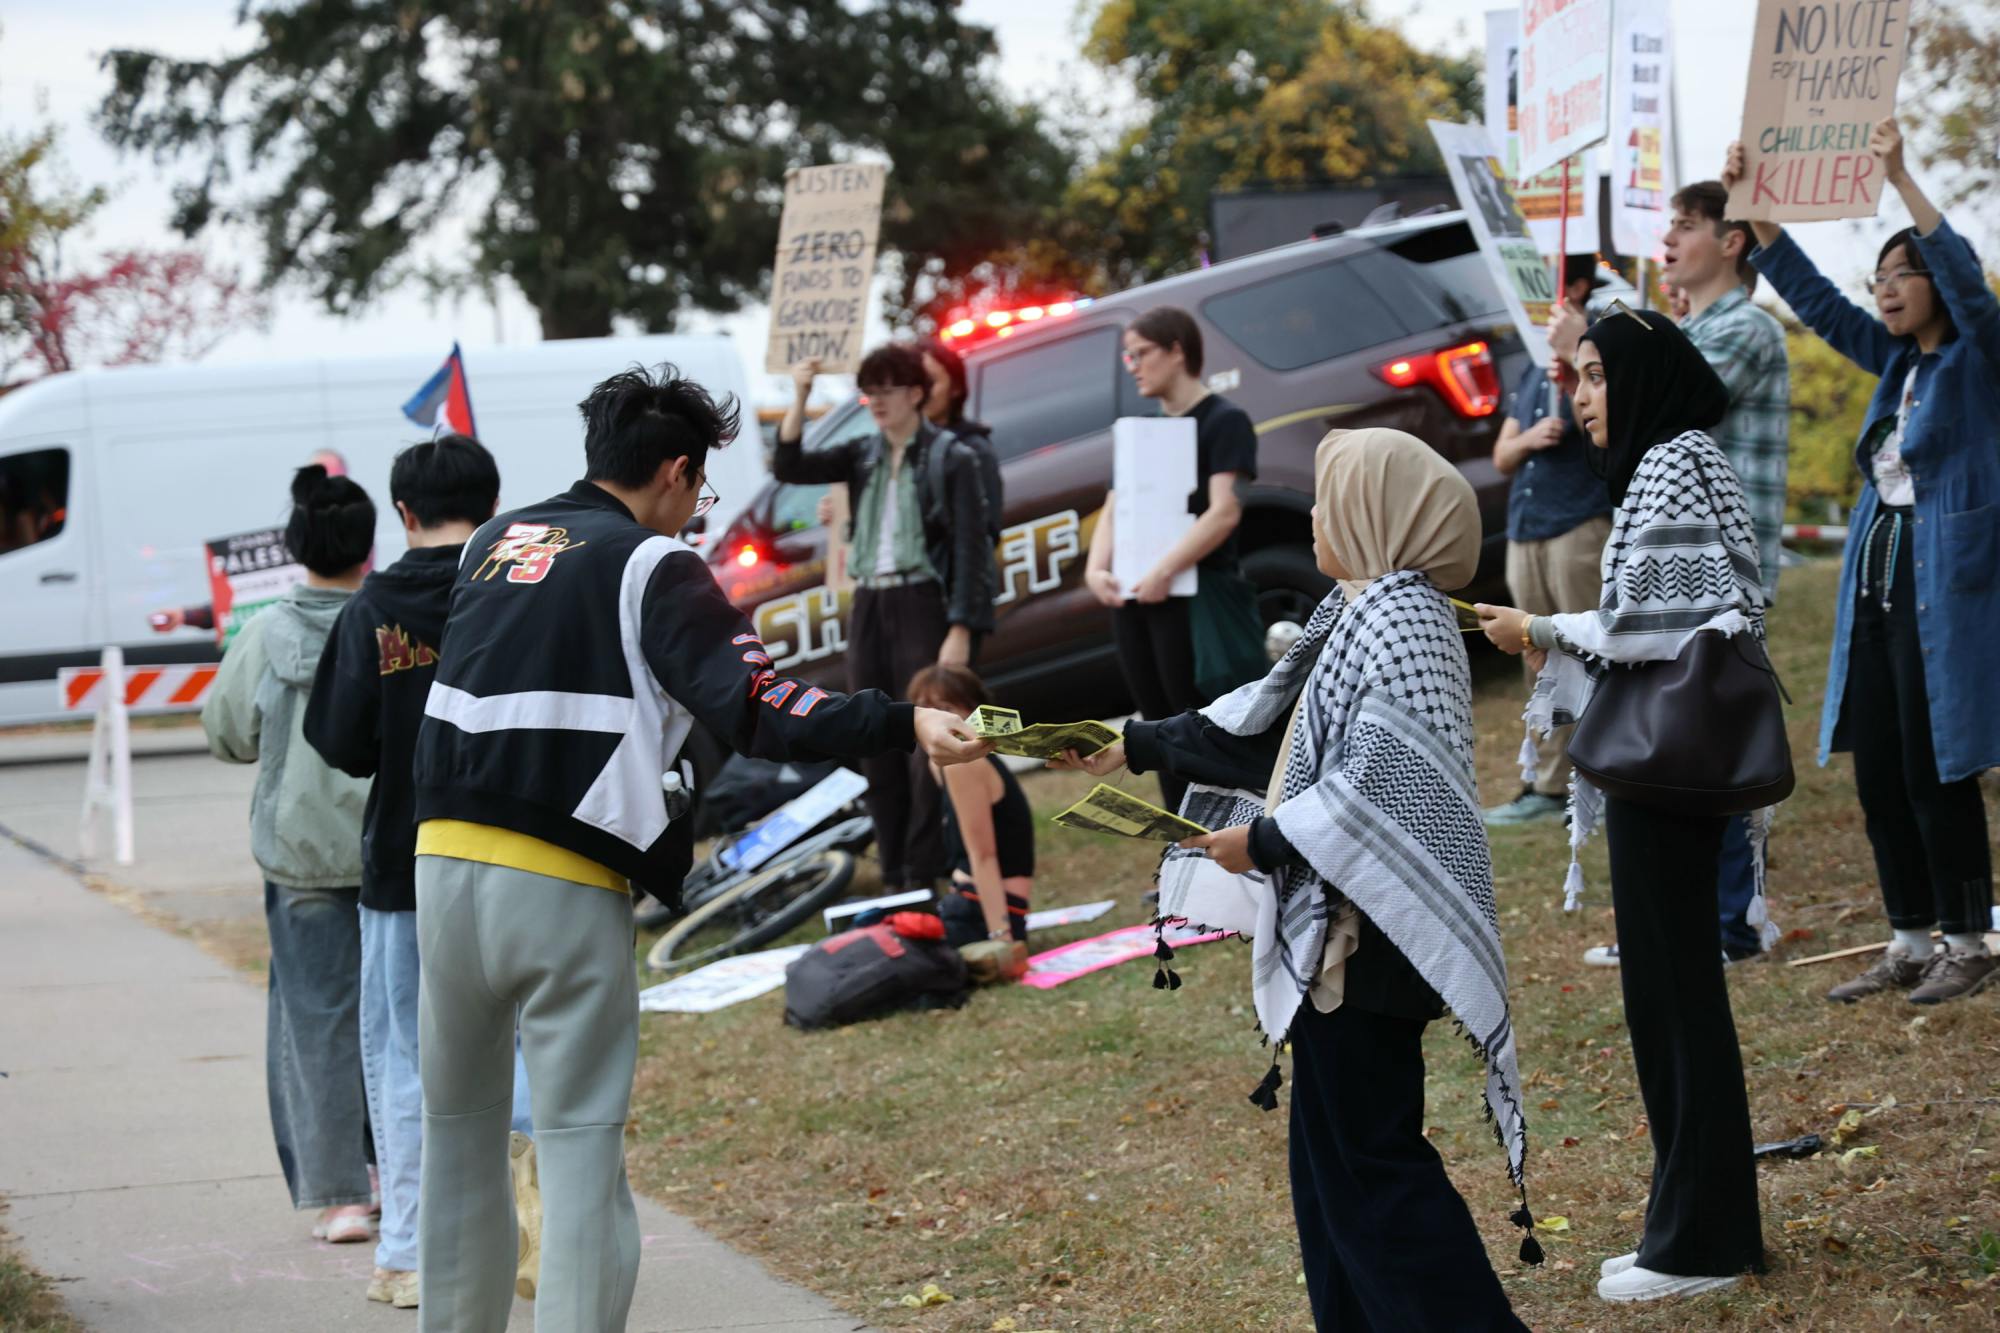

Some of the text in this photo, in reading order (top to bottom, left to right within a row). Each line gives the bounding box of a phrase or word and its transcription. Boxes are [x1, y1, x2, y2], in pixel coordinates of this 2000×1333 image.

[1774, 0, 1899, 54] NO VOTE
[1796, 55, 1888, 101] HARRIS
[1759, 122, 1872, 154] CHILDREN
[795, 169, 870, 194] LISTEN
[1751, 154, 1874, 206] KILLER
[789, 230, 865, 264] ZERO
[781, 267, 865, 297] FUNDS TO
[1516, 265, 1554, 299] NO
[778, 298, 861, 328] GENOCIDE
[210, 544, 298, 577] PALES
